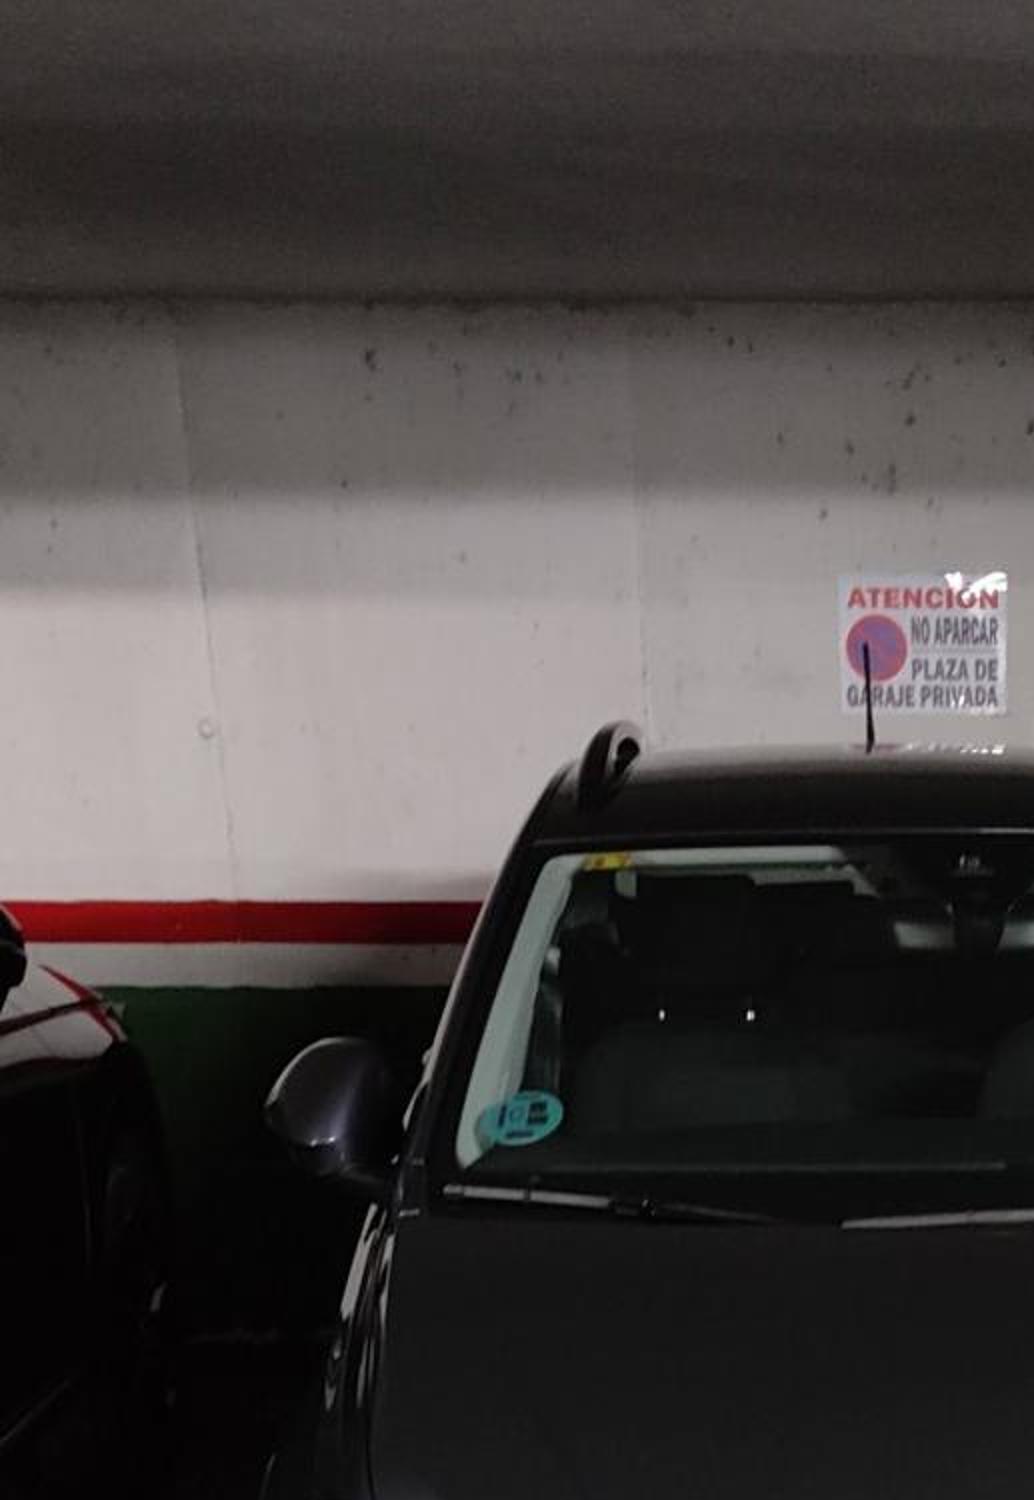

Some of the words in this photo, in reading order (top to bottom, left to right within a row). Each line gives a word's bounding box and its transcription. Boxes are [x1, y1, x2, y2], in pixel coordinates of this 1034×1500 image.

[911, 616, 930, 643] NO
[935, 616, 998, 644] APARCAR
[911, 659, 968, 681] PLAZA
[975, 659, 998, 681] DE
[847, 685, 915, 707] GARAJE
[920, 685, 998, 707] PRIVADA
